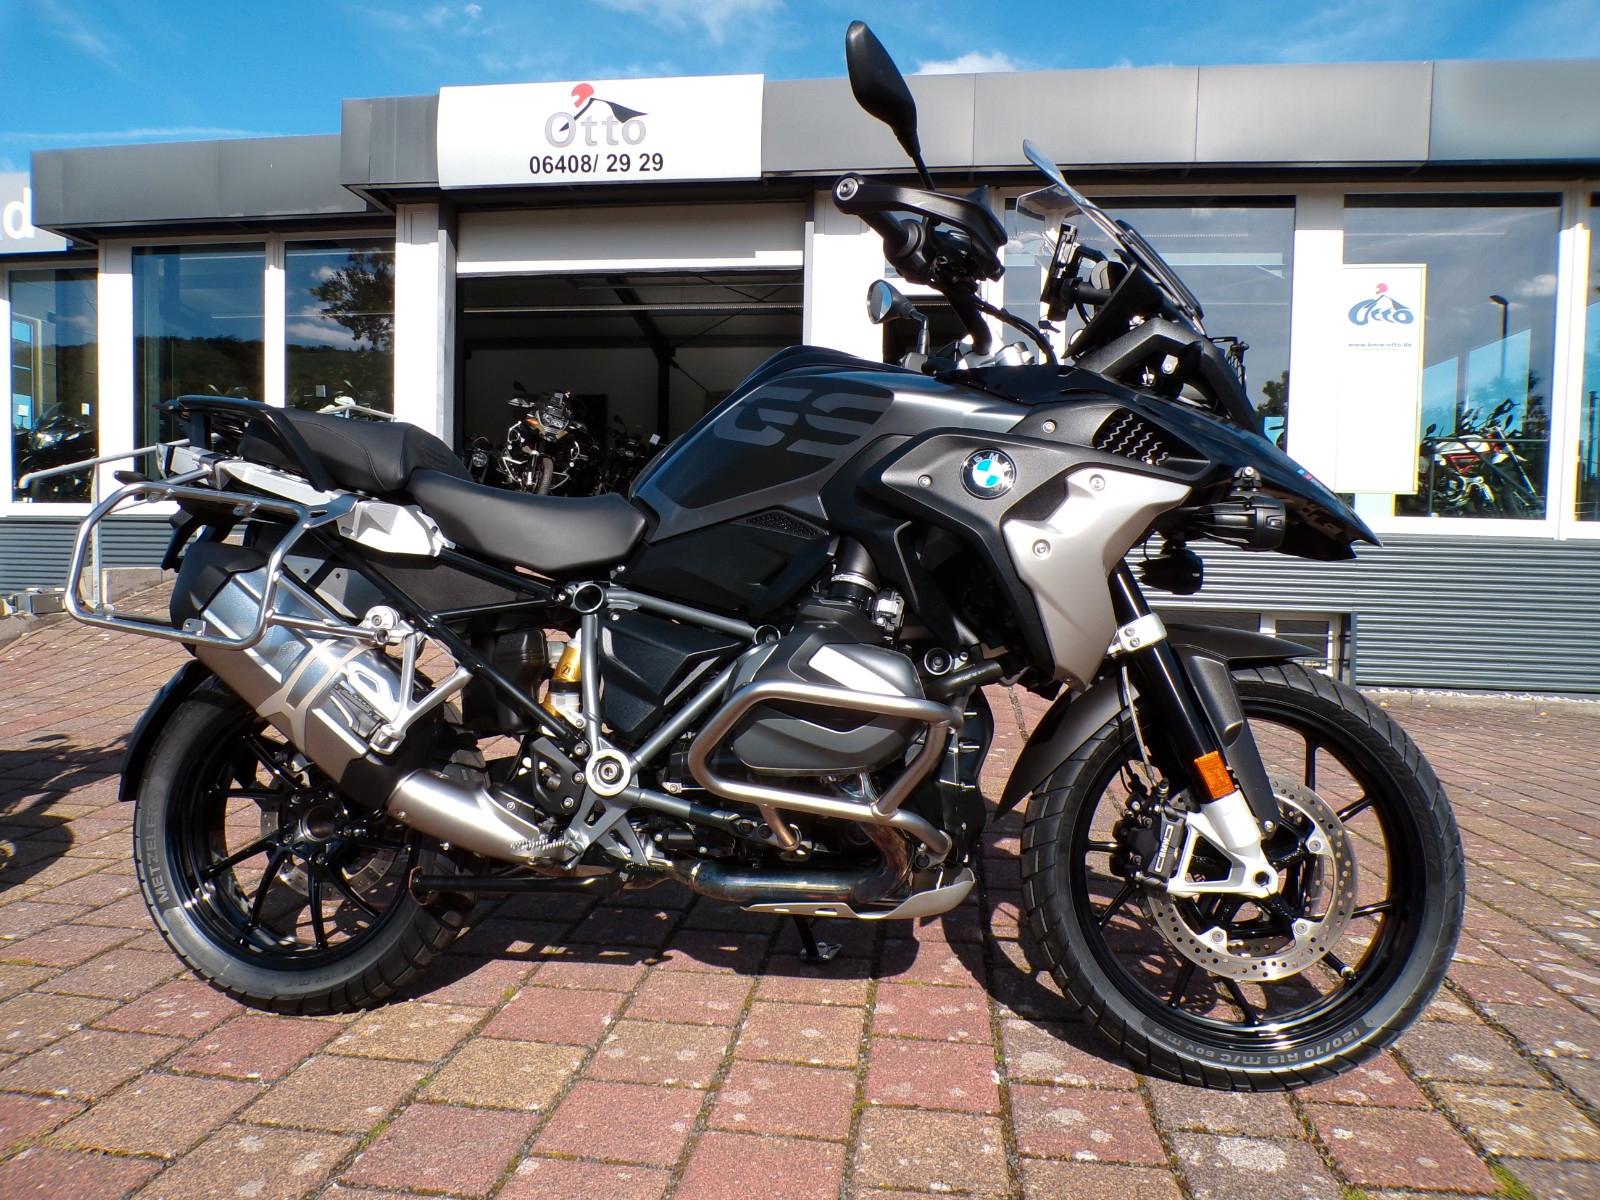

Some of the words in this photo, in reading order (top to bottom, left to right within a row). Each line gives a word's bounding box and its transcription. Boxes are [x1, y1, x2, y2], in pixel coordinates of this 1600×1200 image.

[544, 111, 646, 148] Otto
[529, 154, 600, 175] 06408/
[606, 153, 631, 173] 29
[638, 152, 665, 172] 29
[0, 186, 35, 240] d
[714, 386, 893, 461] GS
